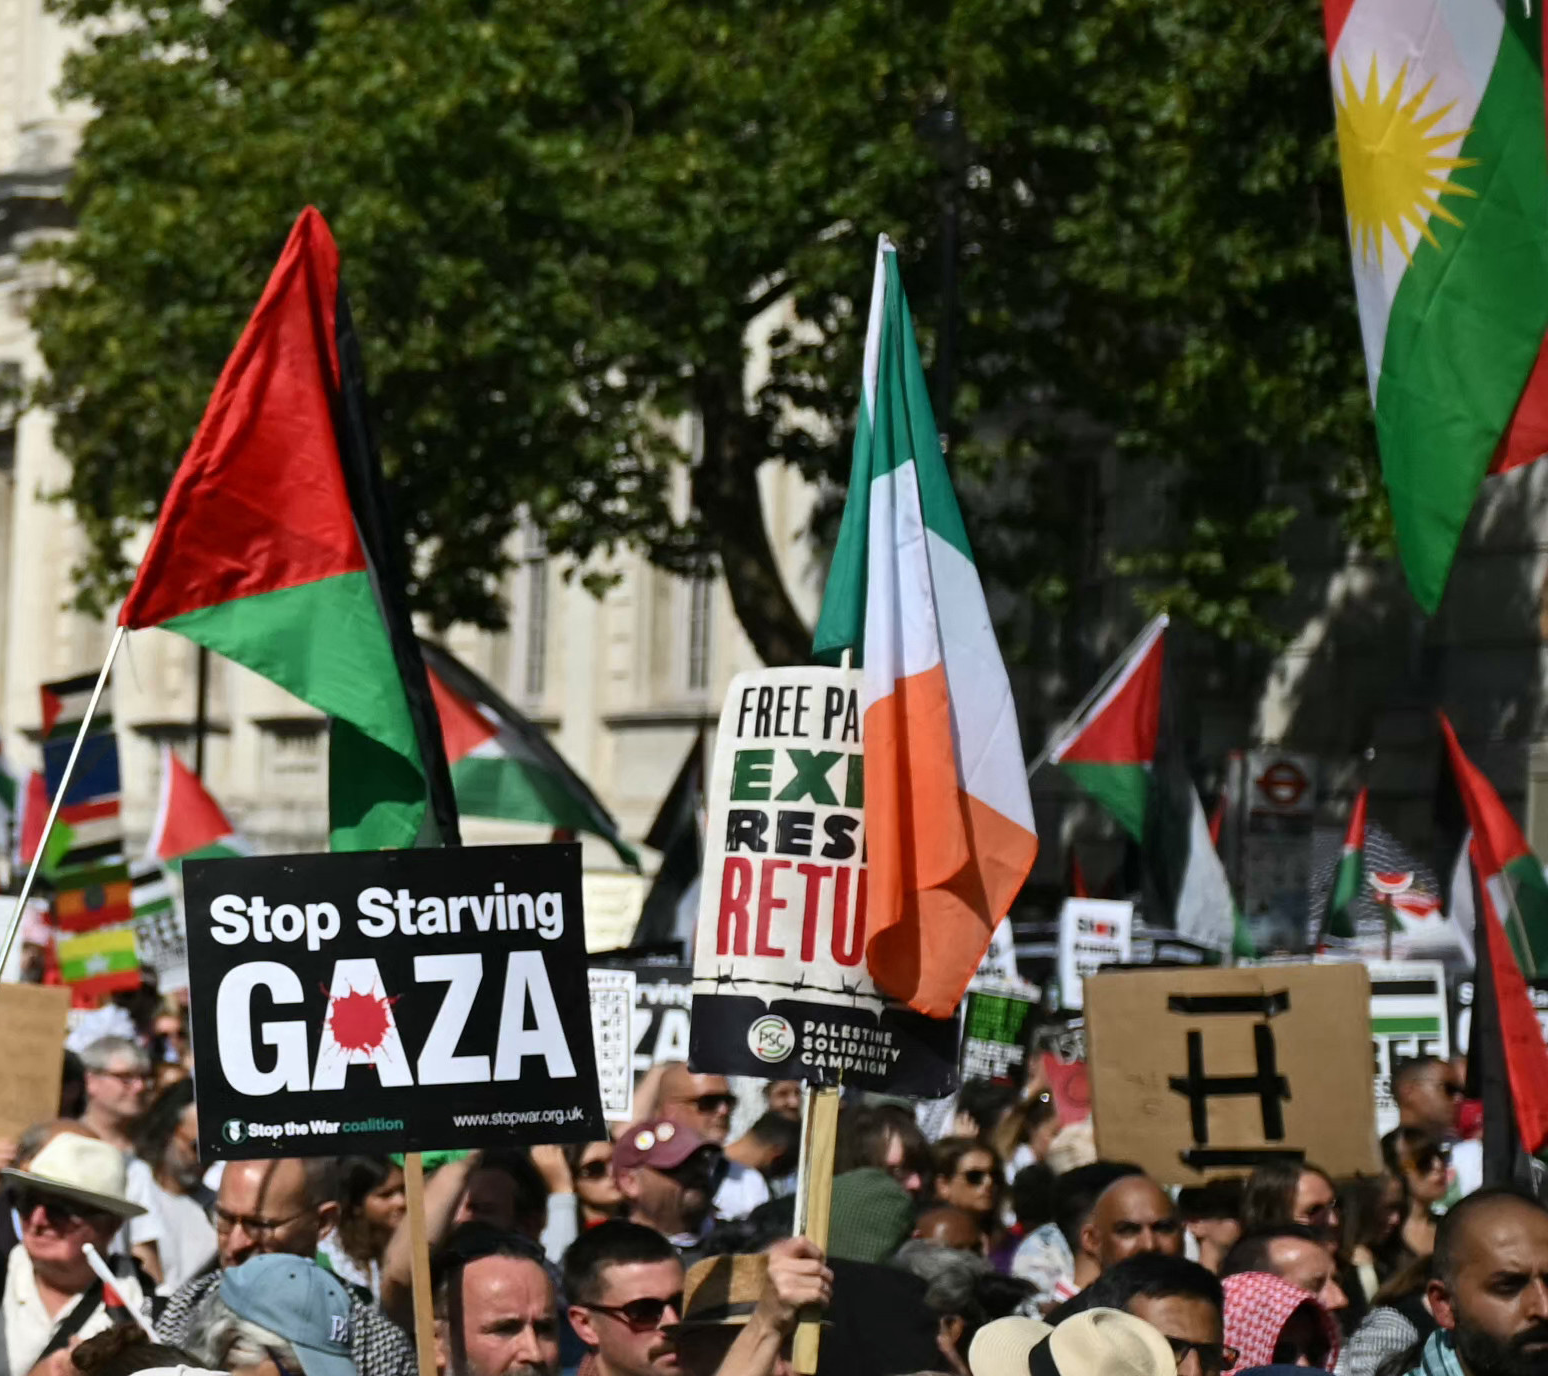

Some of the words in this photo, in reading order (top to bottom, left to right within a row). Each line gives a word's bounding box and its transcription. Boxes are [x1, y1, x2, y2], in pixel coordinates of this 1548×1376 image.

[736, 686, 813, 738] FREE
[729, 748, 864, 808] EXI
[210, 894, 343, 951] Stop
[357, 881, 564, 941] Starving
[716, 857, 868, 966] RETU
[215, 950, 577, 1097] GAZA
[803, 1020, 893, 1046] PALESTINE
[800, 1052, 887, 1077] CAMPAIGN
[801, 1035, 901, 1063] SOLIDARITY
[247, 1121, 284, 1140] Stop
[284, 1121, 309, 1136] the
[309, 1120, 341, 1135] War
[342, 1117, 404, 1133] coalition
[452, 1105, 584, 1128] www.stopwar.org.uk
